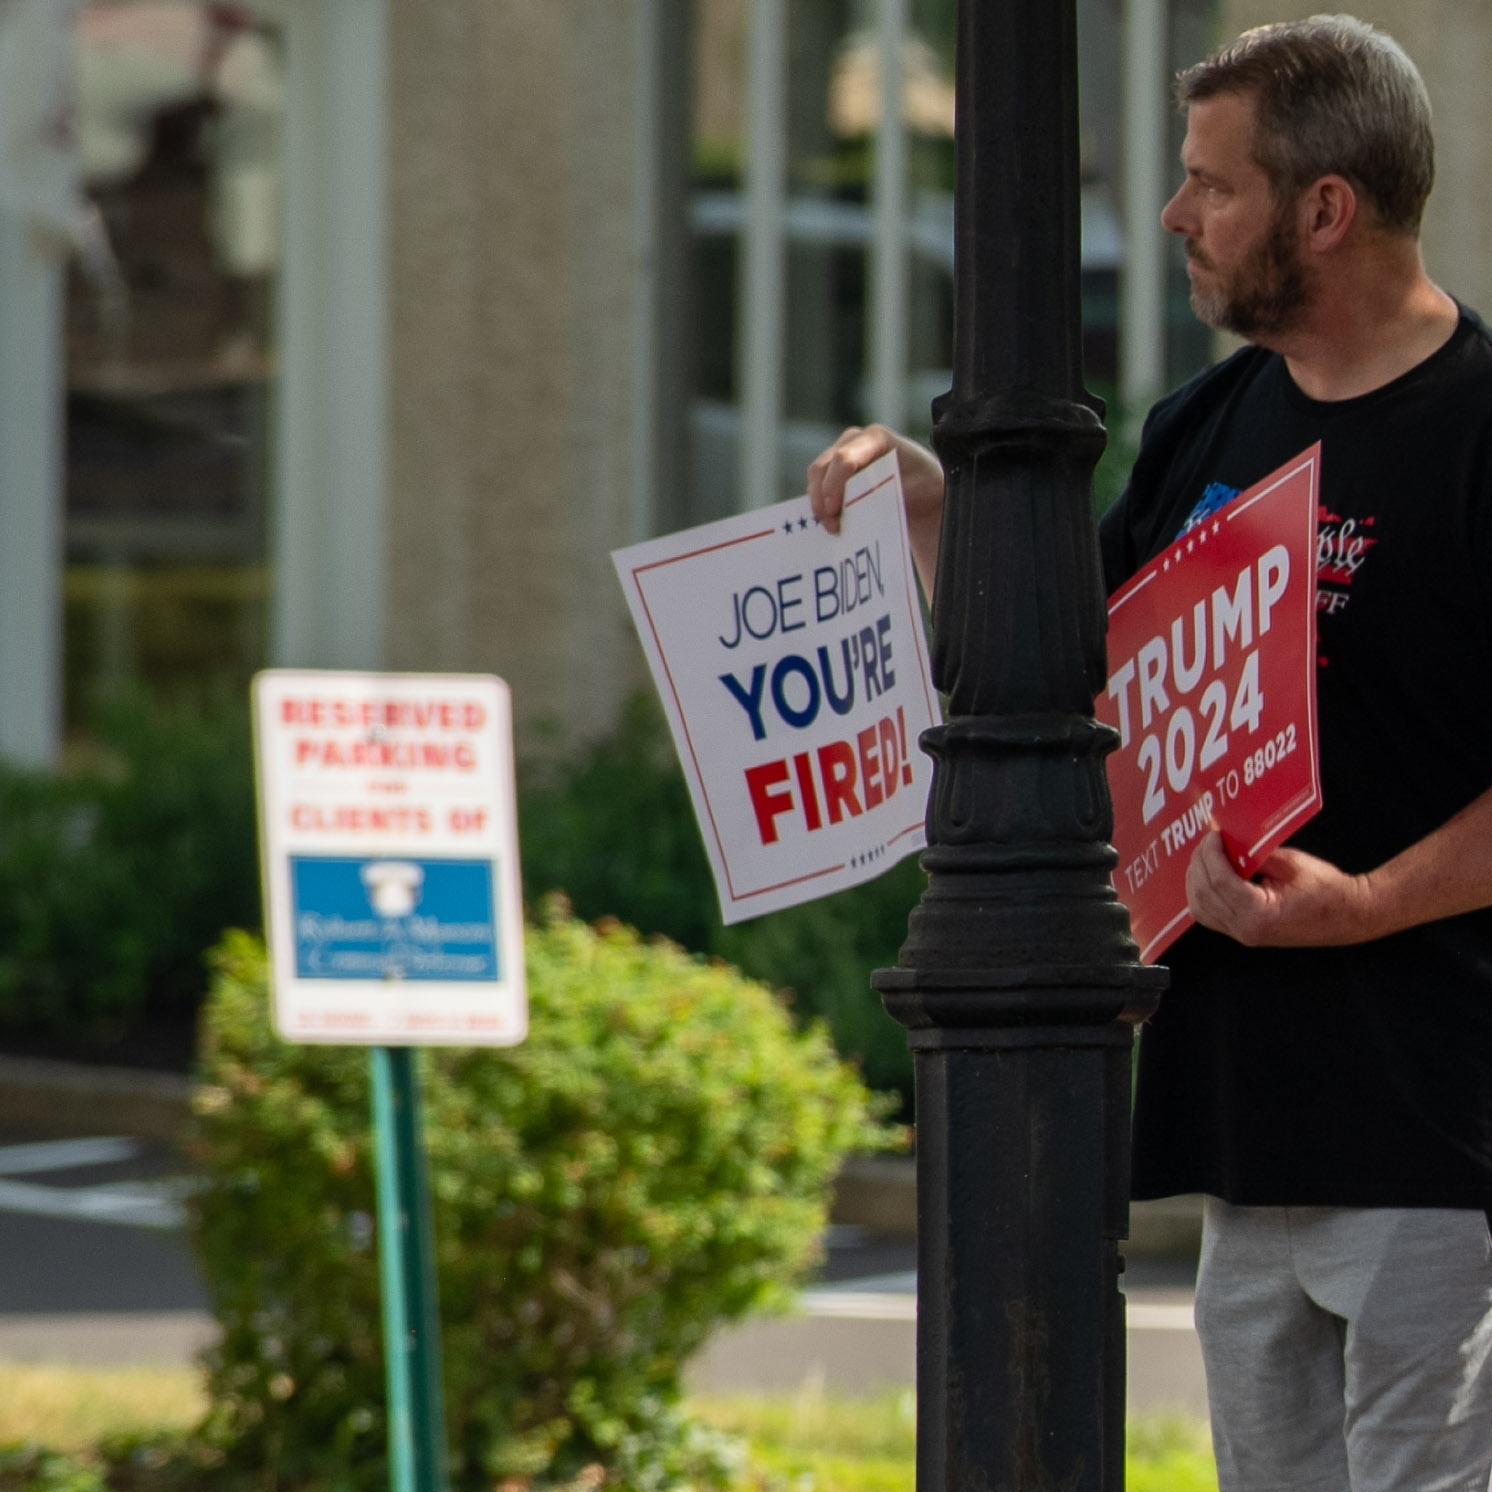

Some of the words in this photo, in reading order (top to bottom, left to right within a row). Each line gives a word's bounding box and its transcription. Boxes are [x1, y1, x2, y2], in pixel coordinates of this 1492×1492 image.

[718, 613, 896, 741] YOU'RE
[719, 574, 804, 649] JOE
[1108, 544, 1291, 750] TRUMP
[281, 700, 487, 729] RESERVED
[296, 740, 476, 770] PARKING
[744, 705, 913, 846] FIRED!
[1136, 649, 1264, 826] 2024
[1123, 842, 1160, 895] TEXT
[1160, 790, 1214, 859] TRUMP
[1216, 768, 1240, 807] TO
[1243, 722, 1297, 786] 88022
